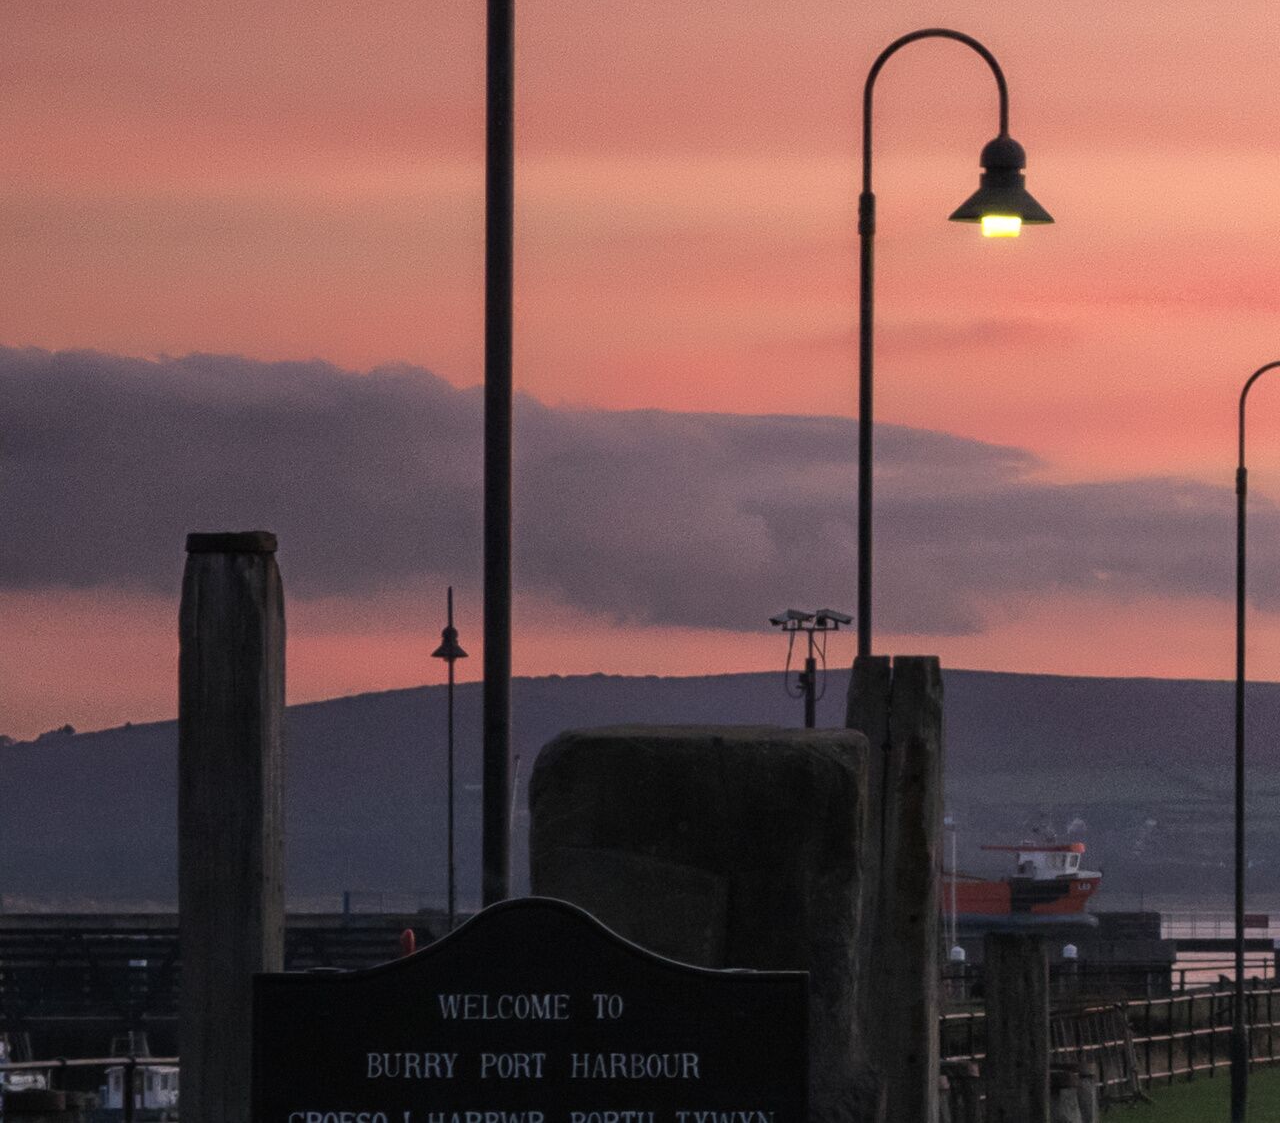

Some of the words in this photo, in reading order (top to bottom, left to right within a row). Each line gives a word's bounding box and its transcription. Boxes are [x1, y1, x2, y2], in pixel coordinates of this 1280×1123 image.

[439, 994, 569, 1019] WELCOME
[593, 994, 623, 1019] TO
[367, 1052, 457, 1078] BURRY
[481, 1052, 546, 1078] PORT
[572, 1052, 699, 1078] HARBOUR
